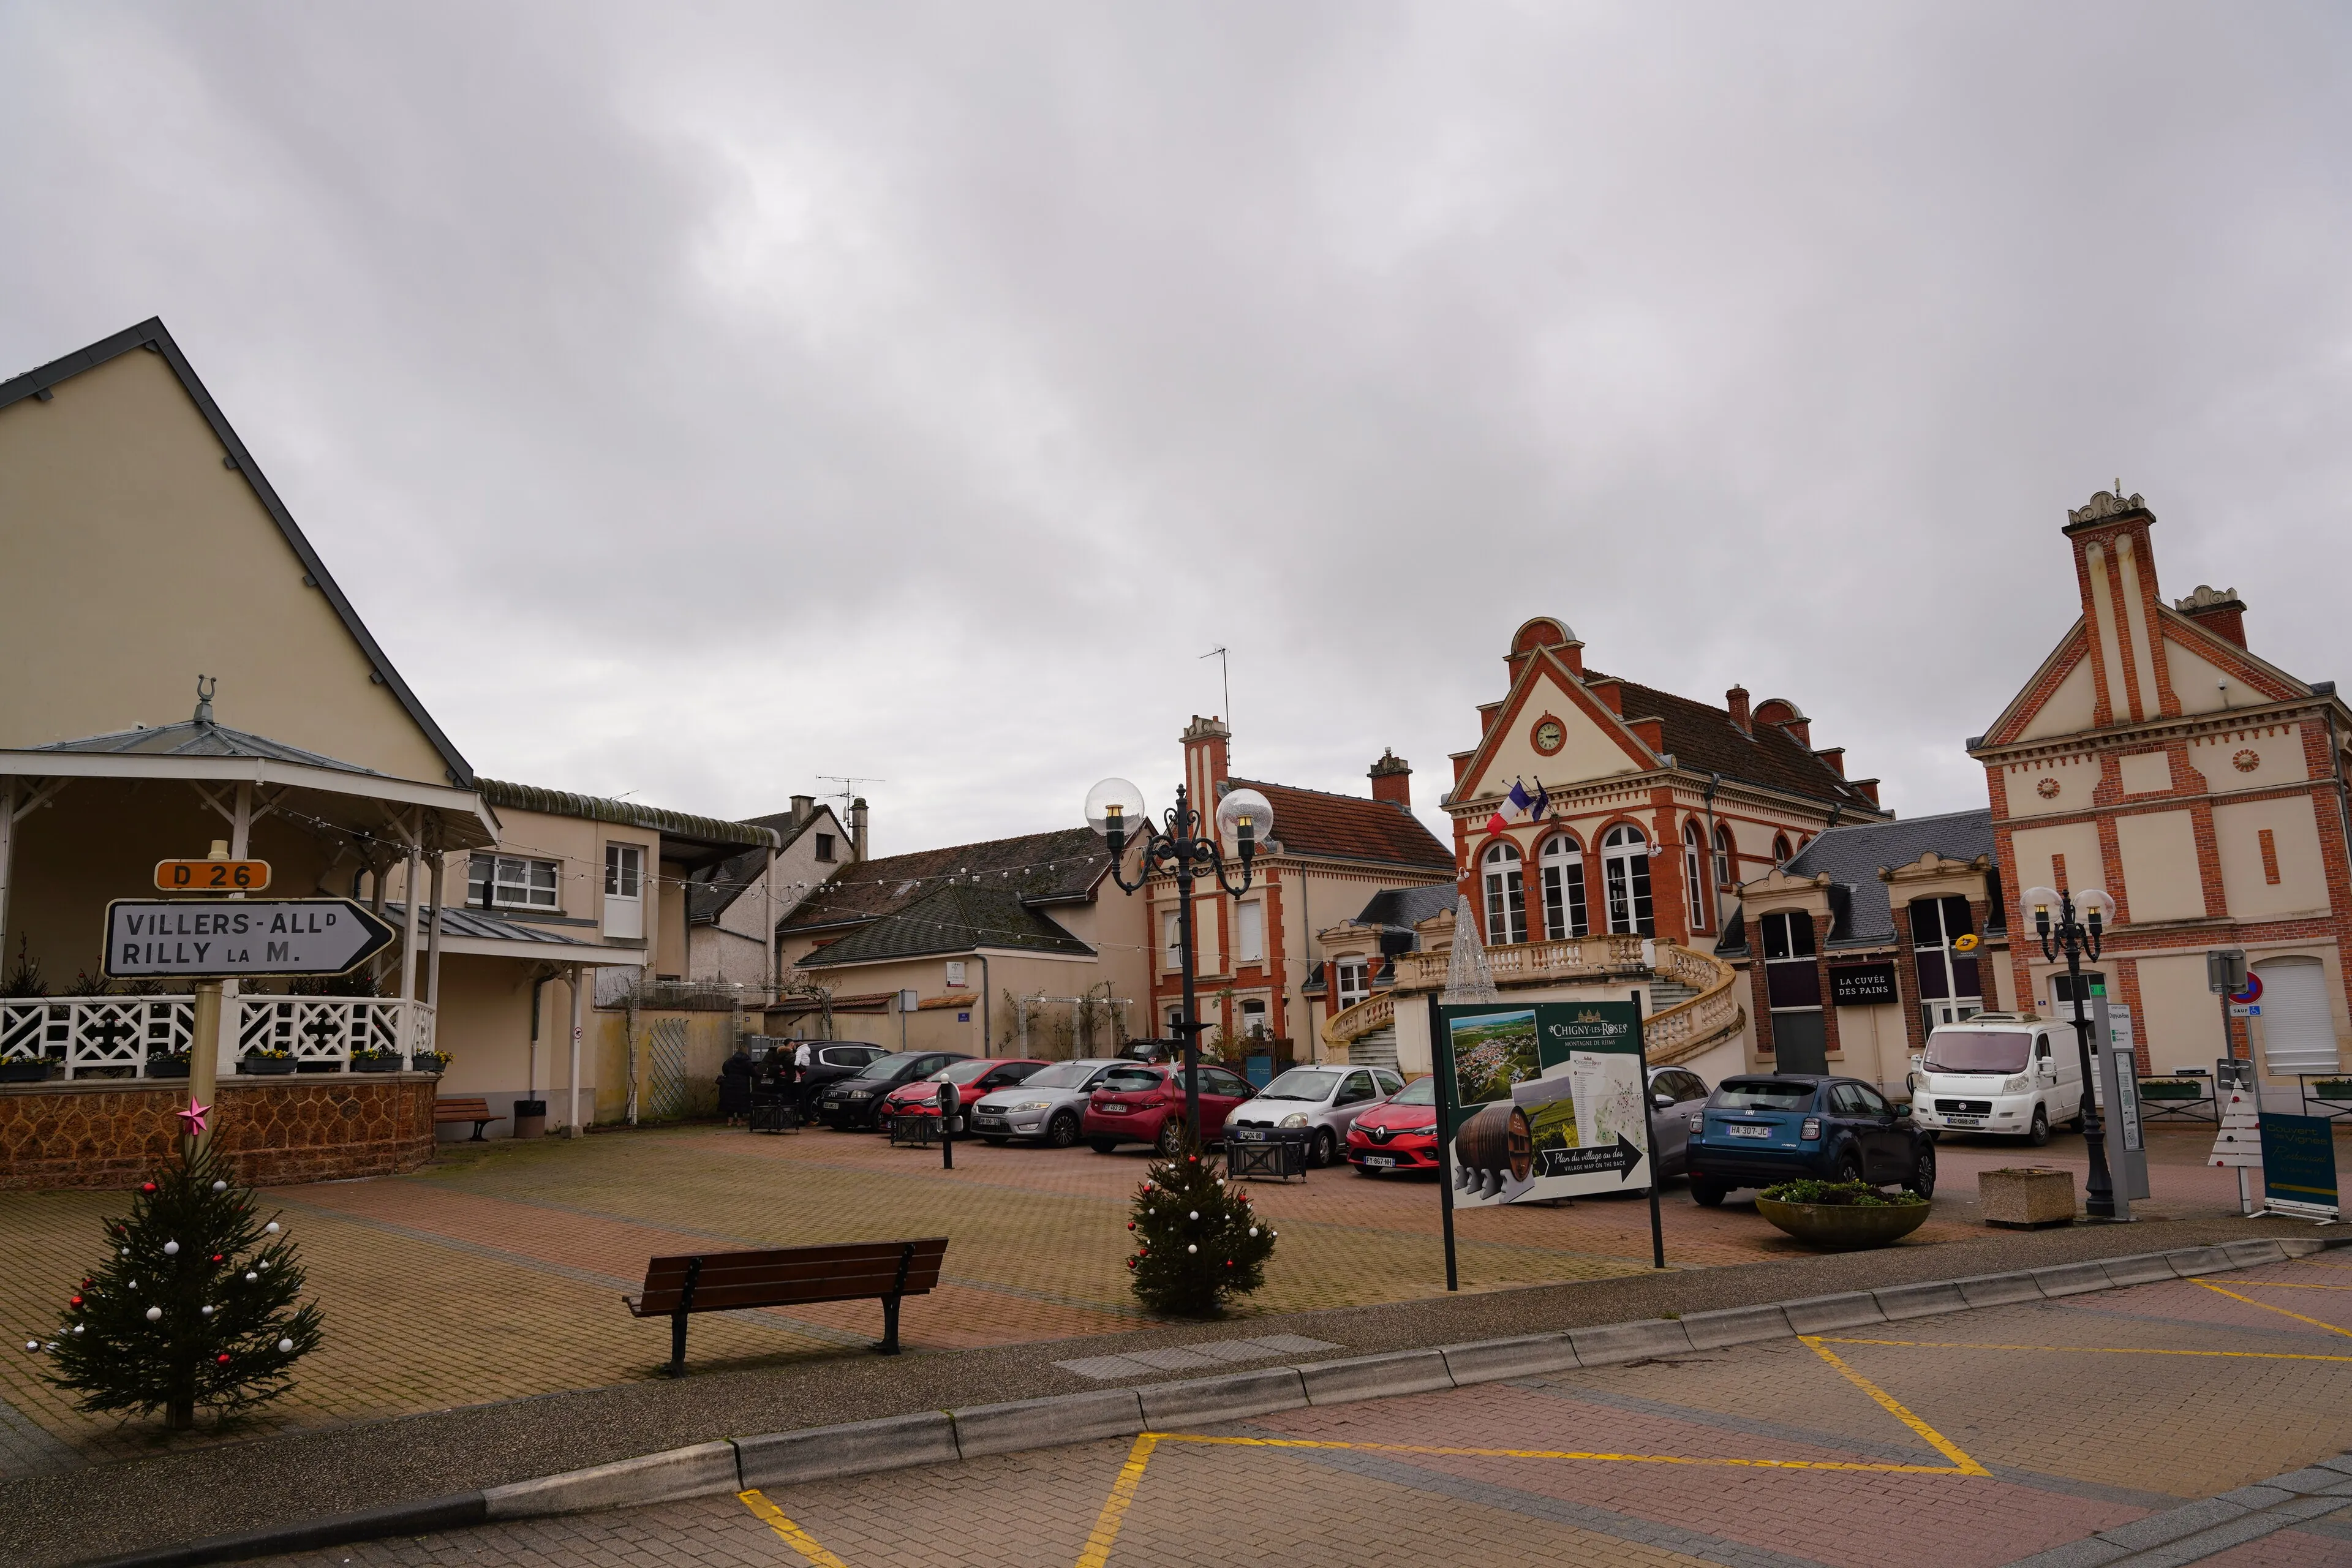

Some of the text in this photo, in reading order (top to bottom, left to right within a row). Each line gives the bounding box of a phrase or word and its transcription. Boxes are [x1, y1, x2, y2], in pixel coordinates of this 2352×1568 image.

[175, 865, 251, 886] D 26
[123, 941, 300, 965] RILLY LA M.
[1855, 974, 1885, 984] CUVÉE
[1860, 986, 1888, 995] PAINS
[1731, 1127, 1768, 1136] HA-307-JC
[2266, 1123, 2318, 1136] Couvert
[2285, 1134, 2328, 1145] Vignes
[1555, 1152, 1570, 1164] Plan
[1571, 1151, 1580, 1162] du
[1581, 1150, 1602, 1163] village
[1612, 1147, 1624, 1158] dos
[2271, 1145, 2328, 1163] Restaurant
